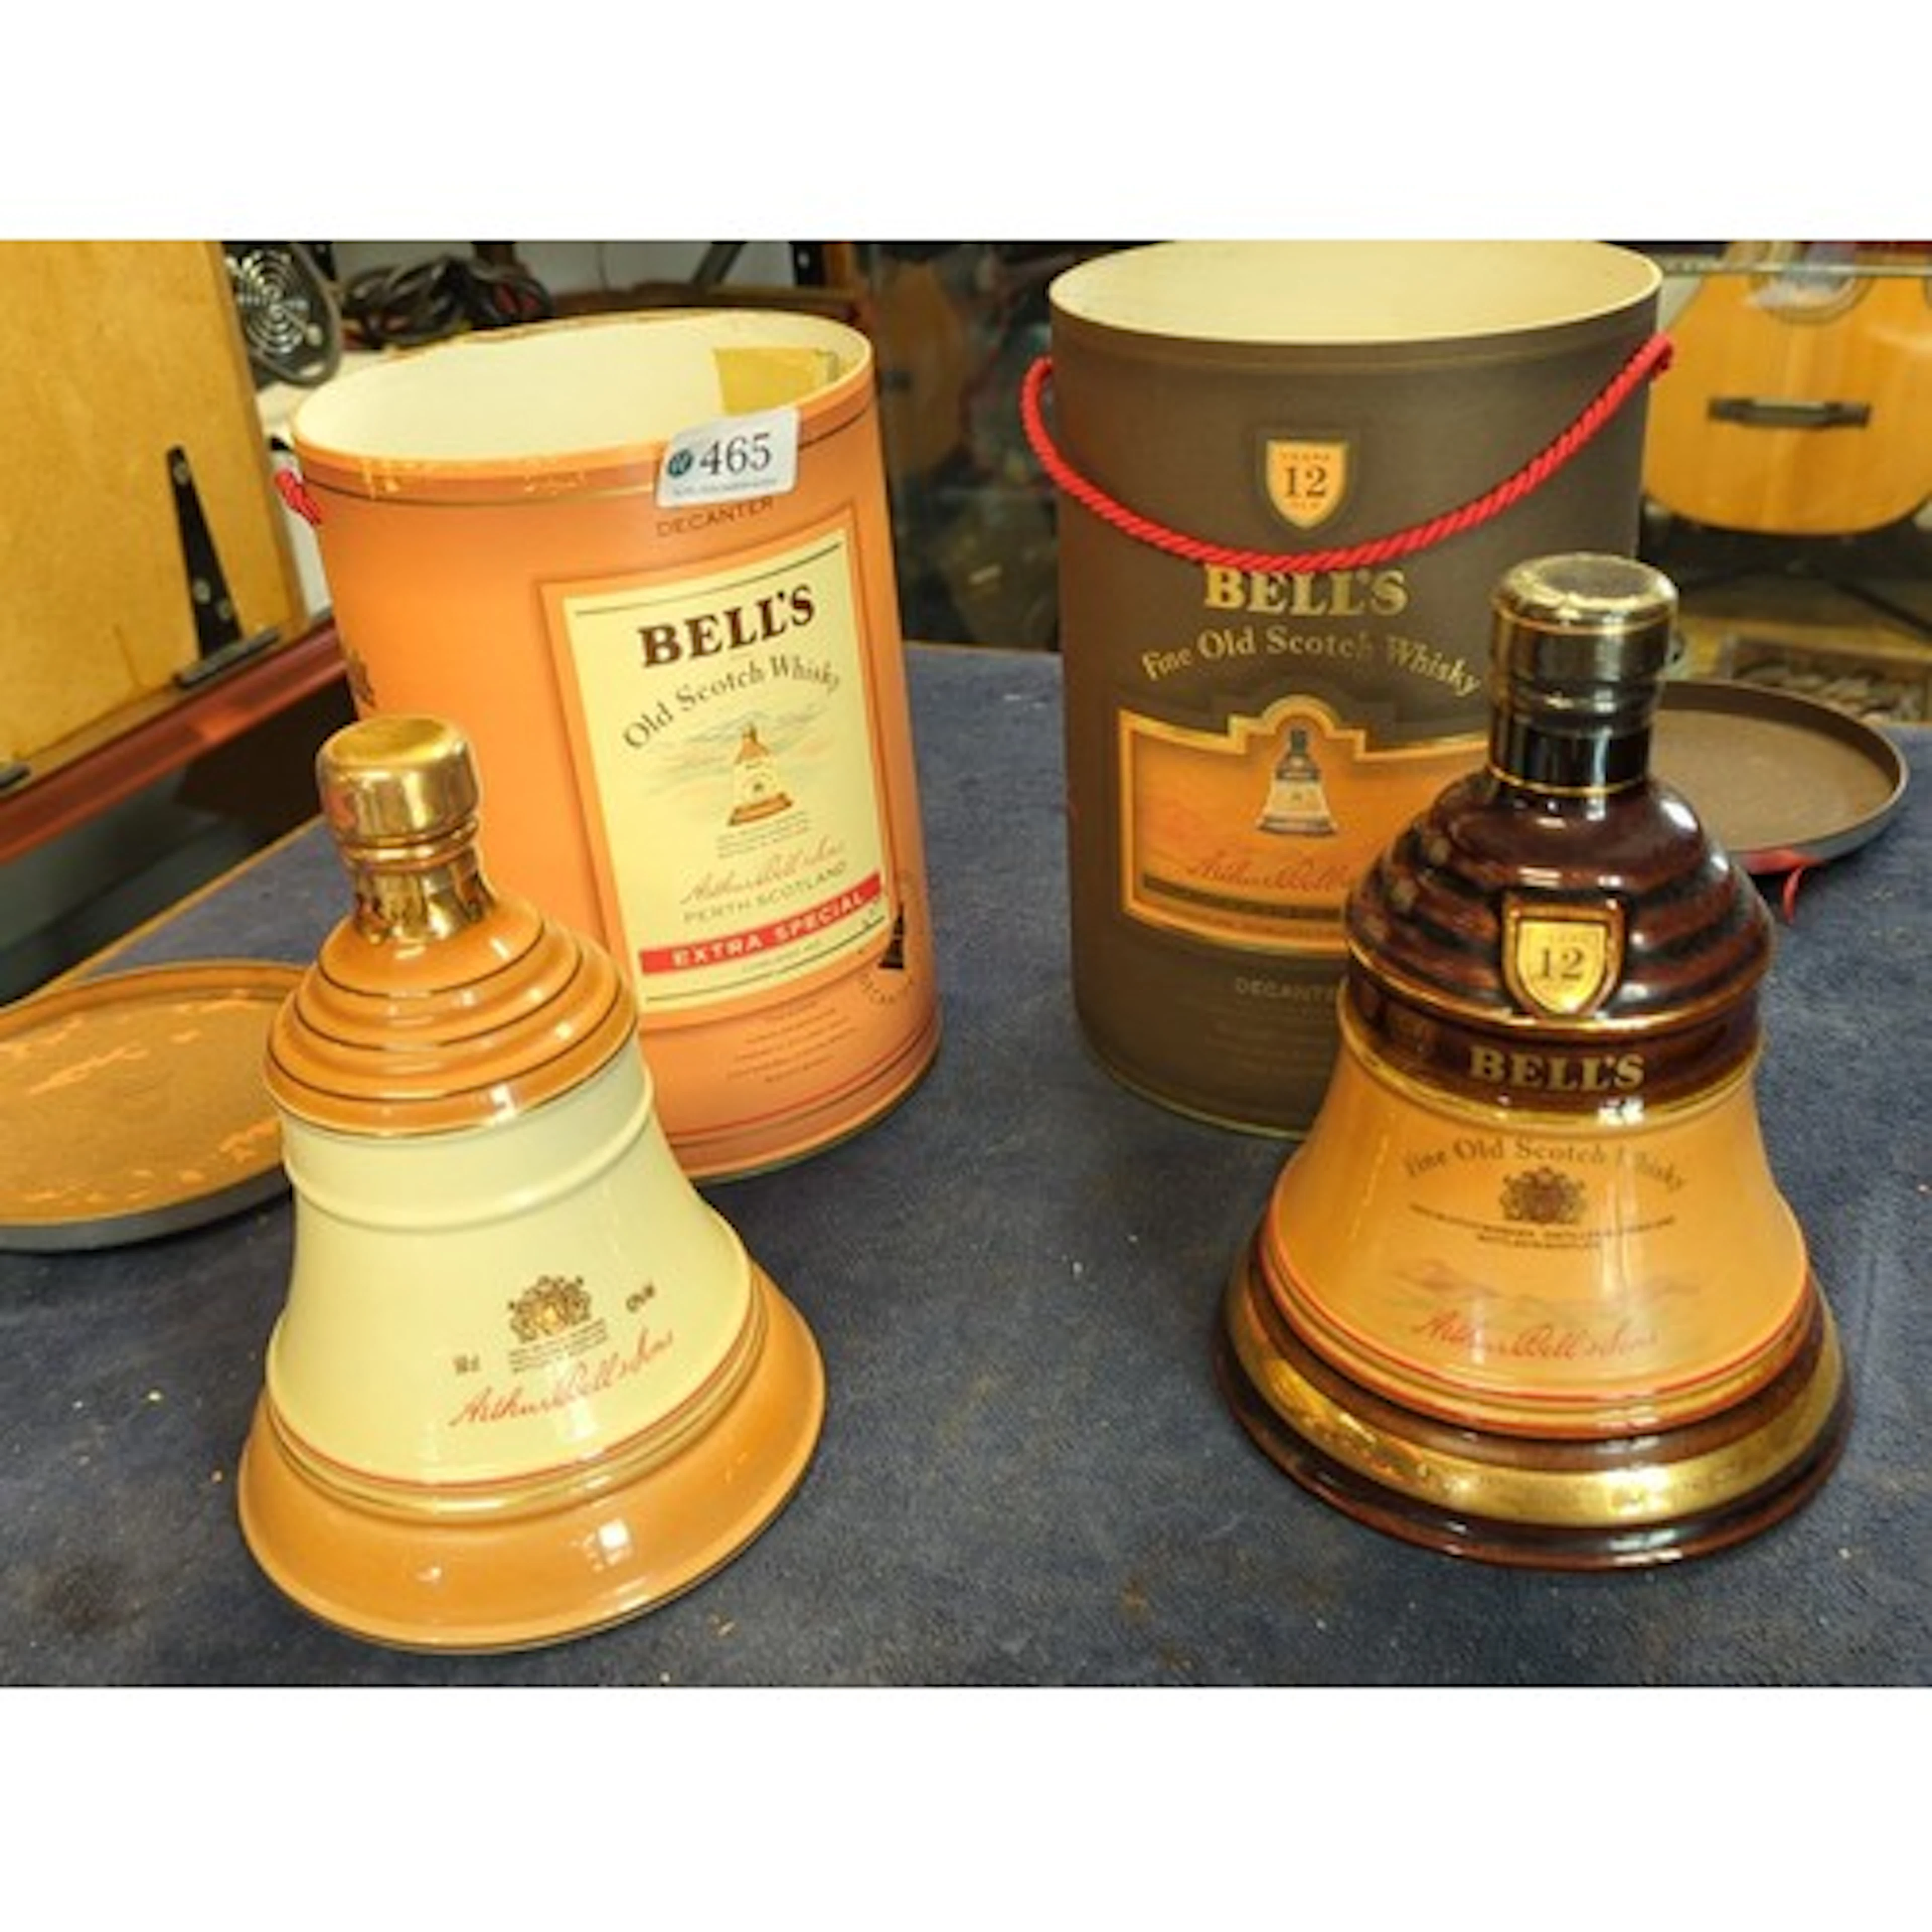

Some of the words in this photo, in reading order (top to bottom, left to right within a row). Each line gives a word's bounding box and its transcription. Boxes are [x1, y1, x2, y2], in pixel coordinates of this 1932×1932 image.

[699, 432, 772, 475] 465
[1284, 465, 1327, 498] 12
[656, 496, 774, 537] DECANTER
[1203, 564, 1409, 616] BELL'S
[637, 584, 816, 668] BELL'S
[1141, 644, 1192, 682] Fine
[1196, 626, 1257, 660] Old
[1265, 624, 1374, 658] Scotch
[1386, 634, 1482, 697] Whisky
[622, 701, 675, 750] Old
[676, 659, 766, 712] Scotch
[770, 655, 841, 696] Whisky
[671, 932, 763, 968] EXTRA
[773, 890, 864, 945] SPECIAL
[1539, 946, 1585, 981] 12
[1470, 1045, 1645, 1092] BELL'S
[1453, 1136, 1504, 1161] Old
[1513, 1135, 1607, 1165] Scotch
